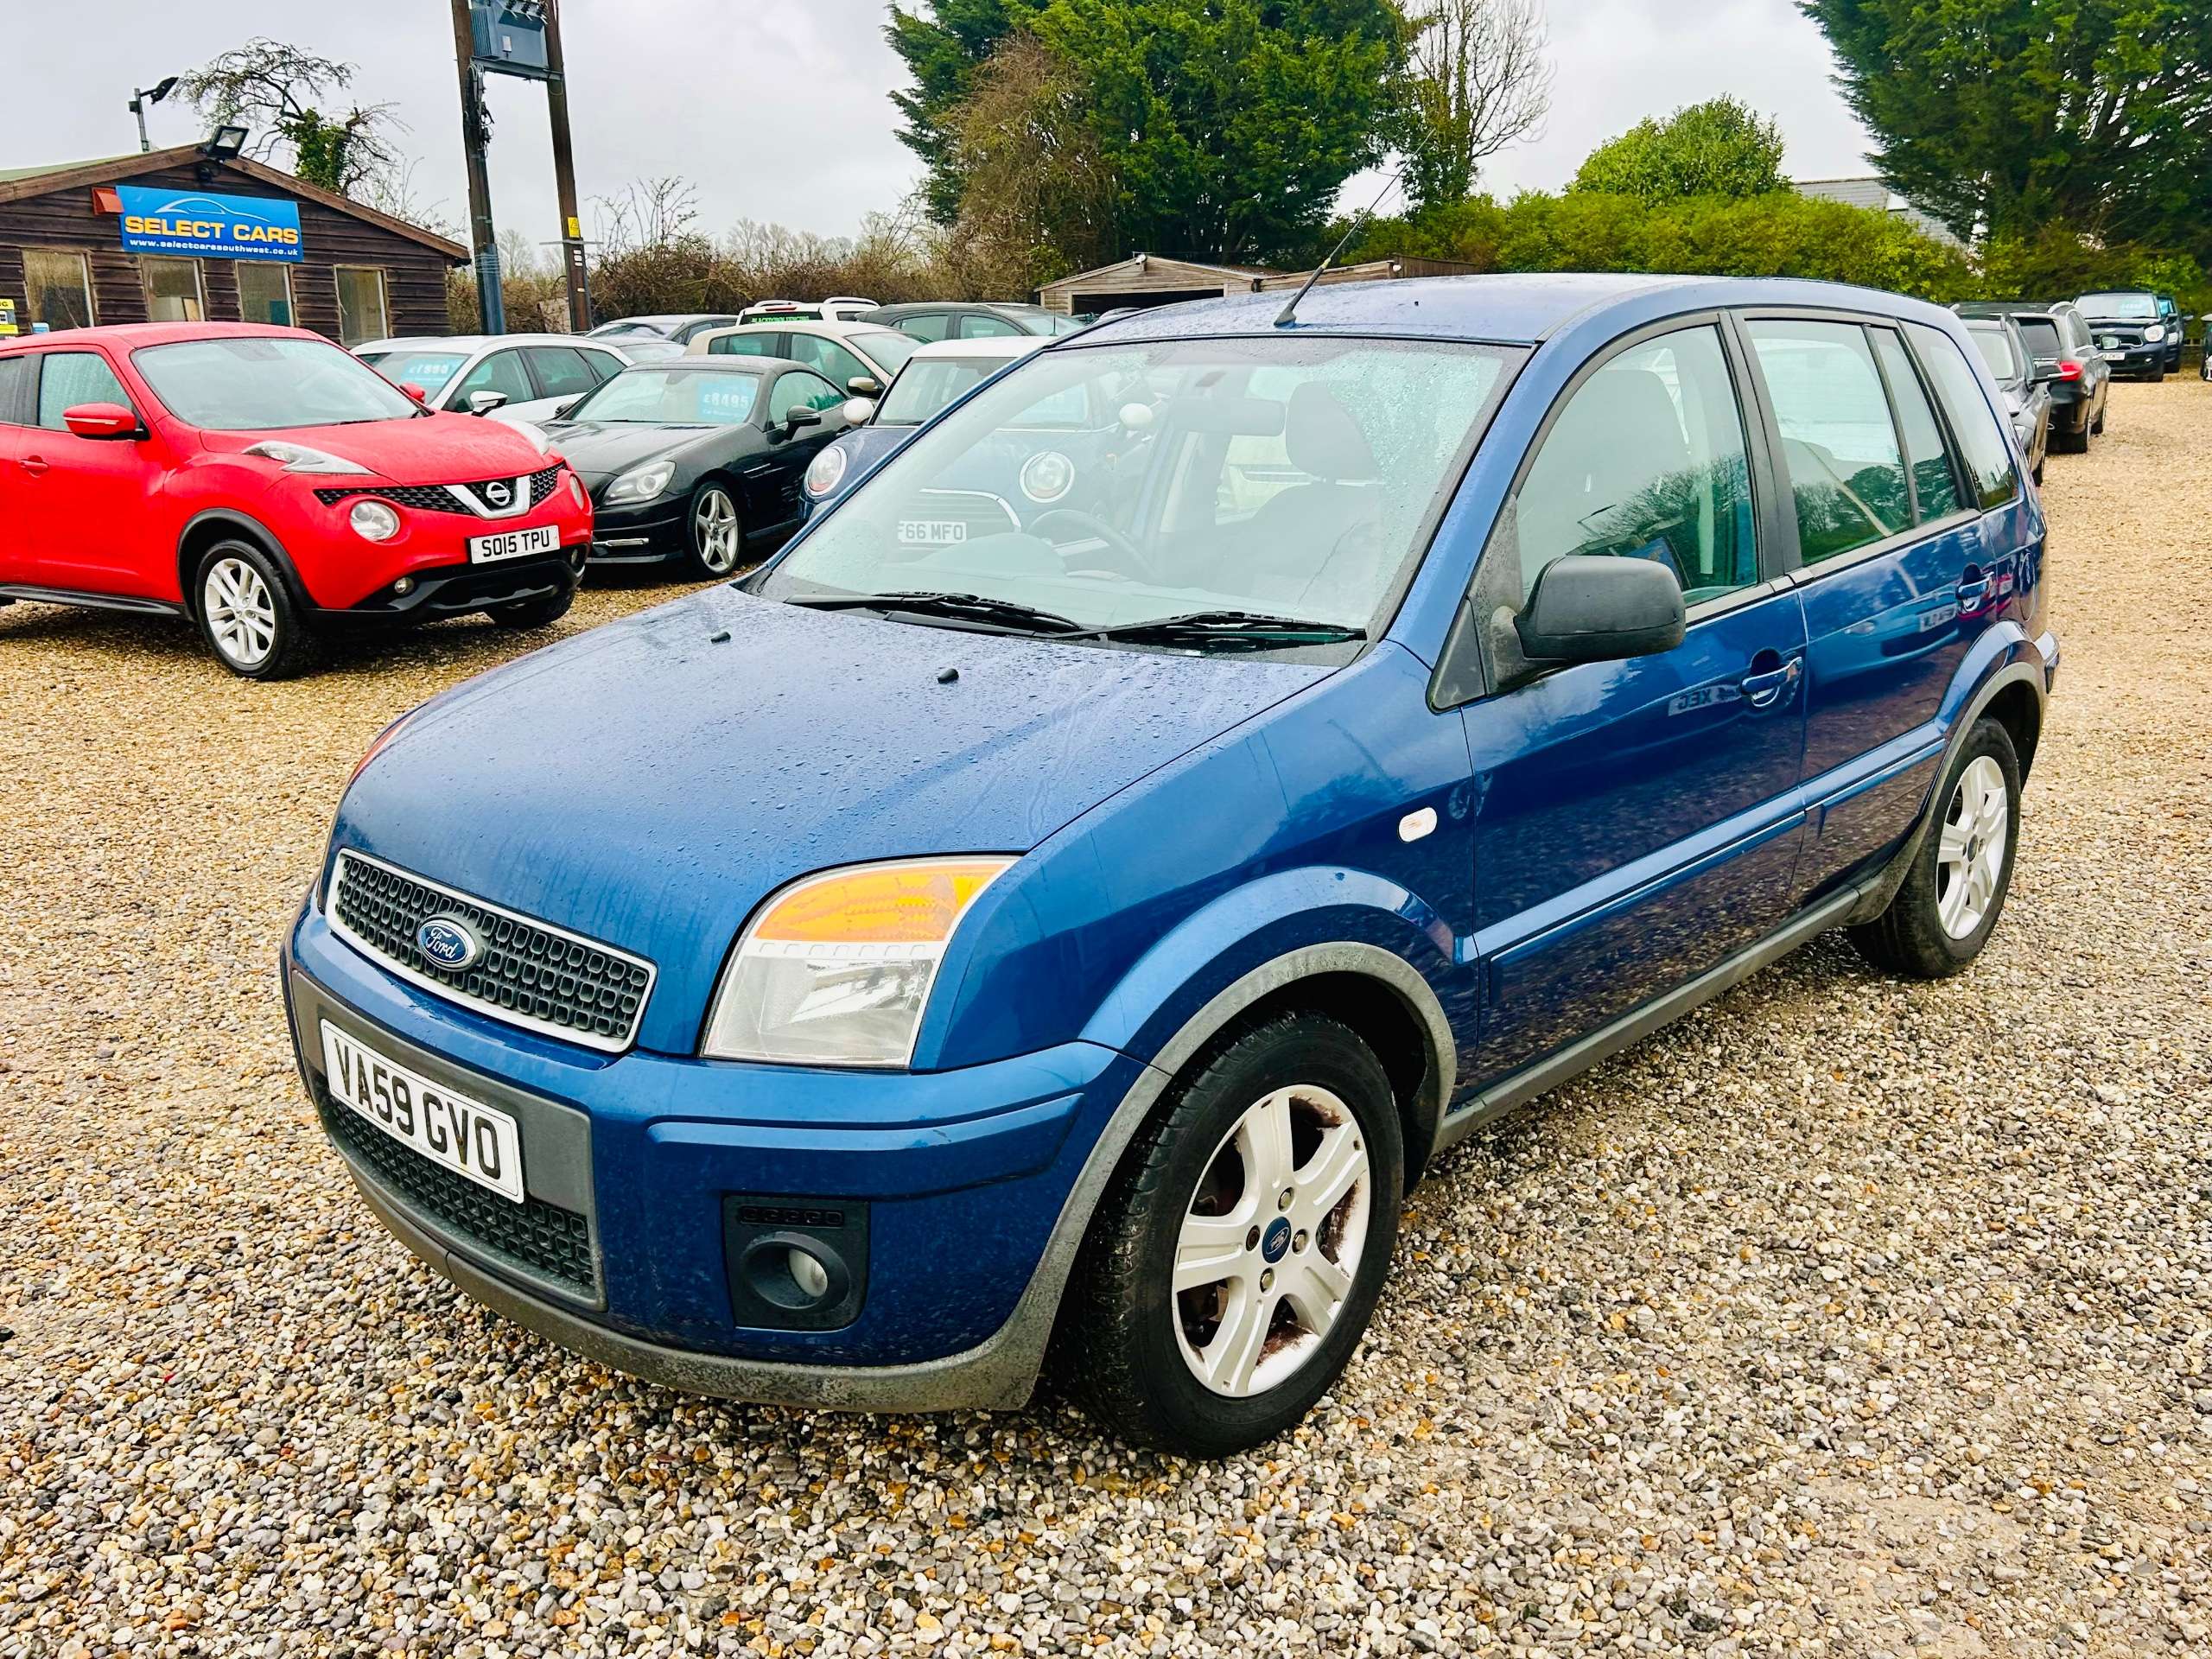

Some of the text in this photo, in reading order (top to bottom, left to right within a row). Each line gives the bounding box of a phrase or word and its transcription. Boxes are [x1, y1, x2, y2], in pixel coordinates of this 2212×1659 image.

[125, 216, 299, 245] SELECT CARS
[130, 238, 298, 256] www.selectcarssouthwest.co.uk
[703, 392, 749, 408] £8495
[481, 530, 550, 557] SO15 TPU
[931, 523, 963, 541] MFO
[425, 926, 460, 959] Ford
[334, 1038, 501, 1179] VA59 GVO
